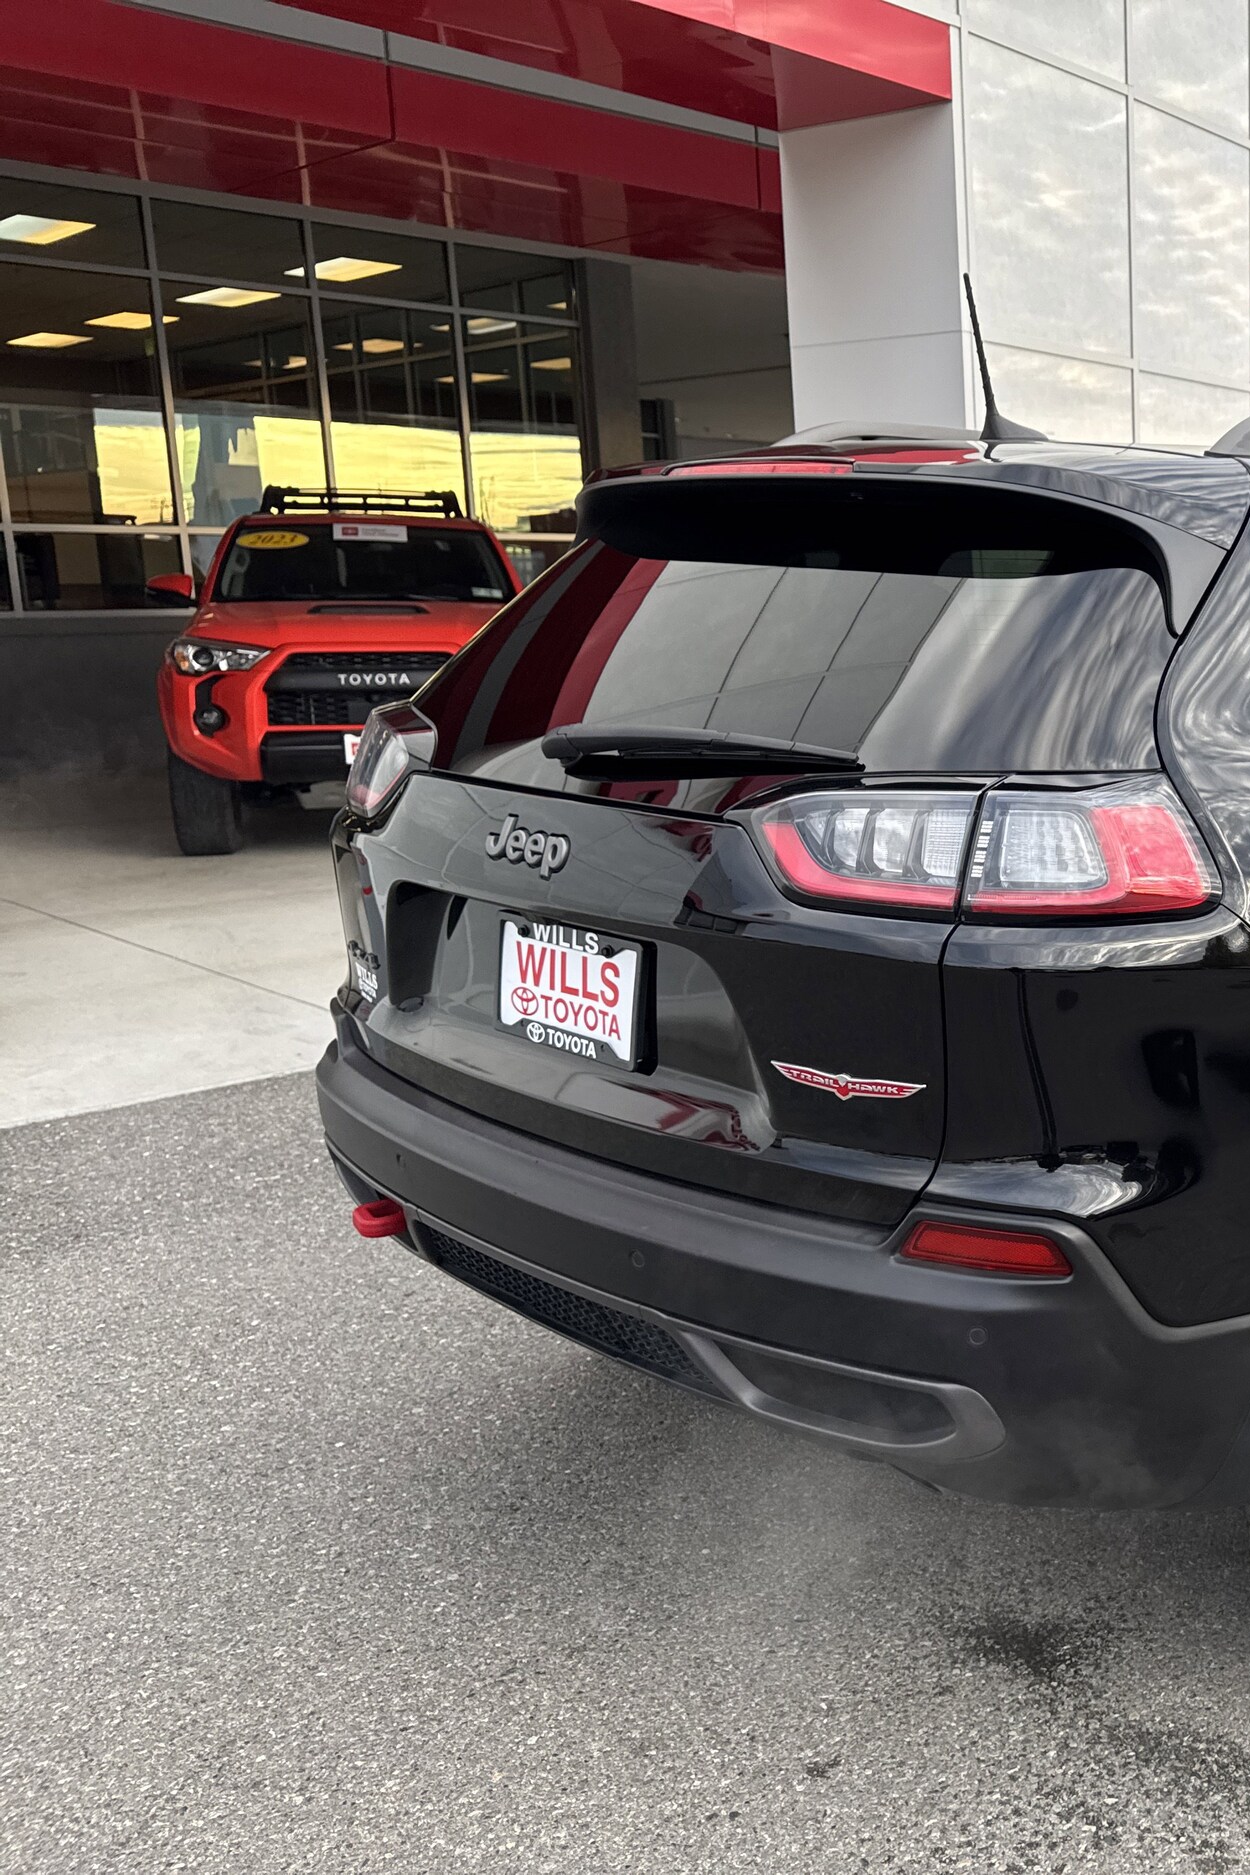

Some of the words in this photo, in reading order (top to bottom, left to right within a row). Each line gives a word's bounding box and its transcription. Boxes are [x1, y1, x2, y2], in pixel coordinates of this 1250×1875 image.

[337, 672, 411, 686] TOYOTA
[485, 813, 571, 881] Jeep
[532, 922, 600, 955] WILLS
[516, 940, 620, 1008] WILLS
[540, 994, 622, 1041] TOYOTA
[546, 1028, 597, 1059] TOYOTA
